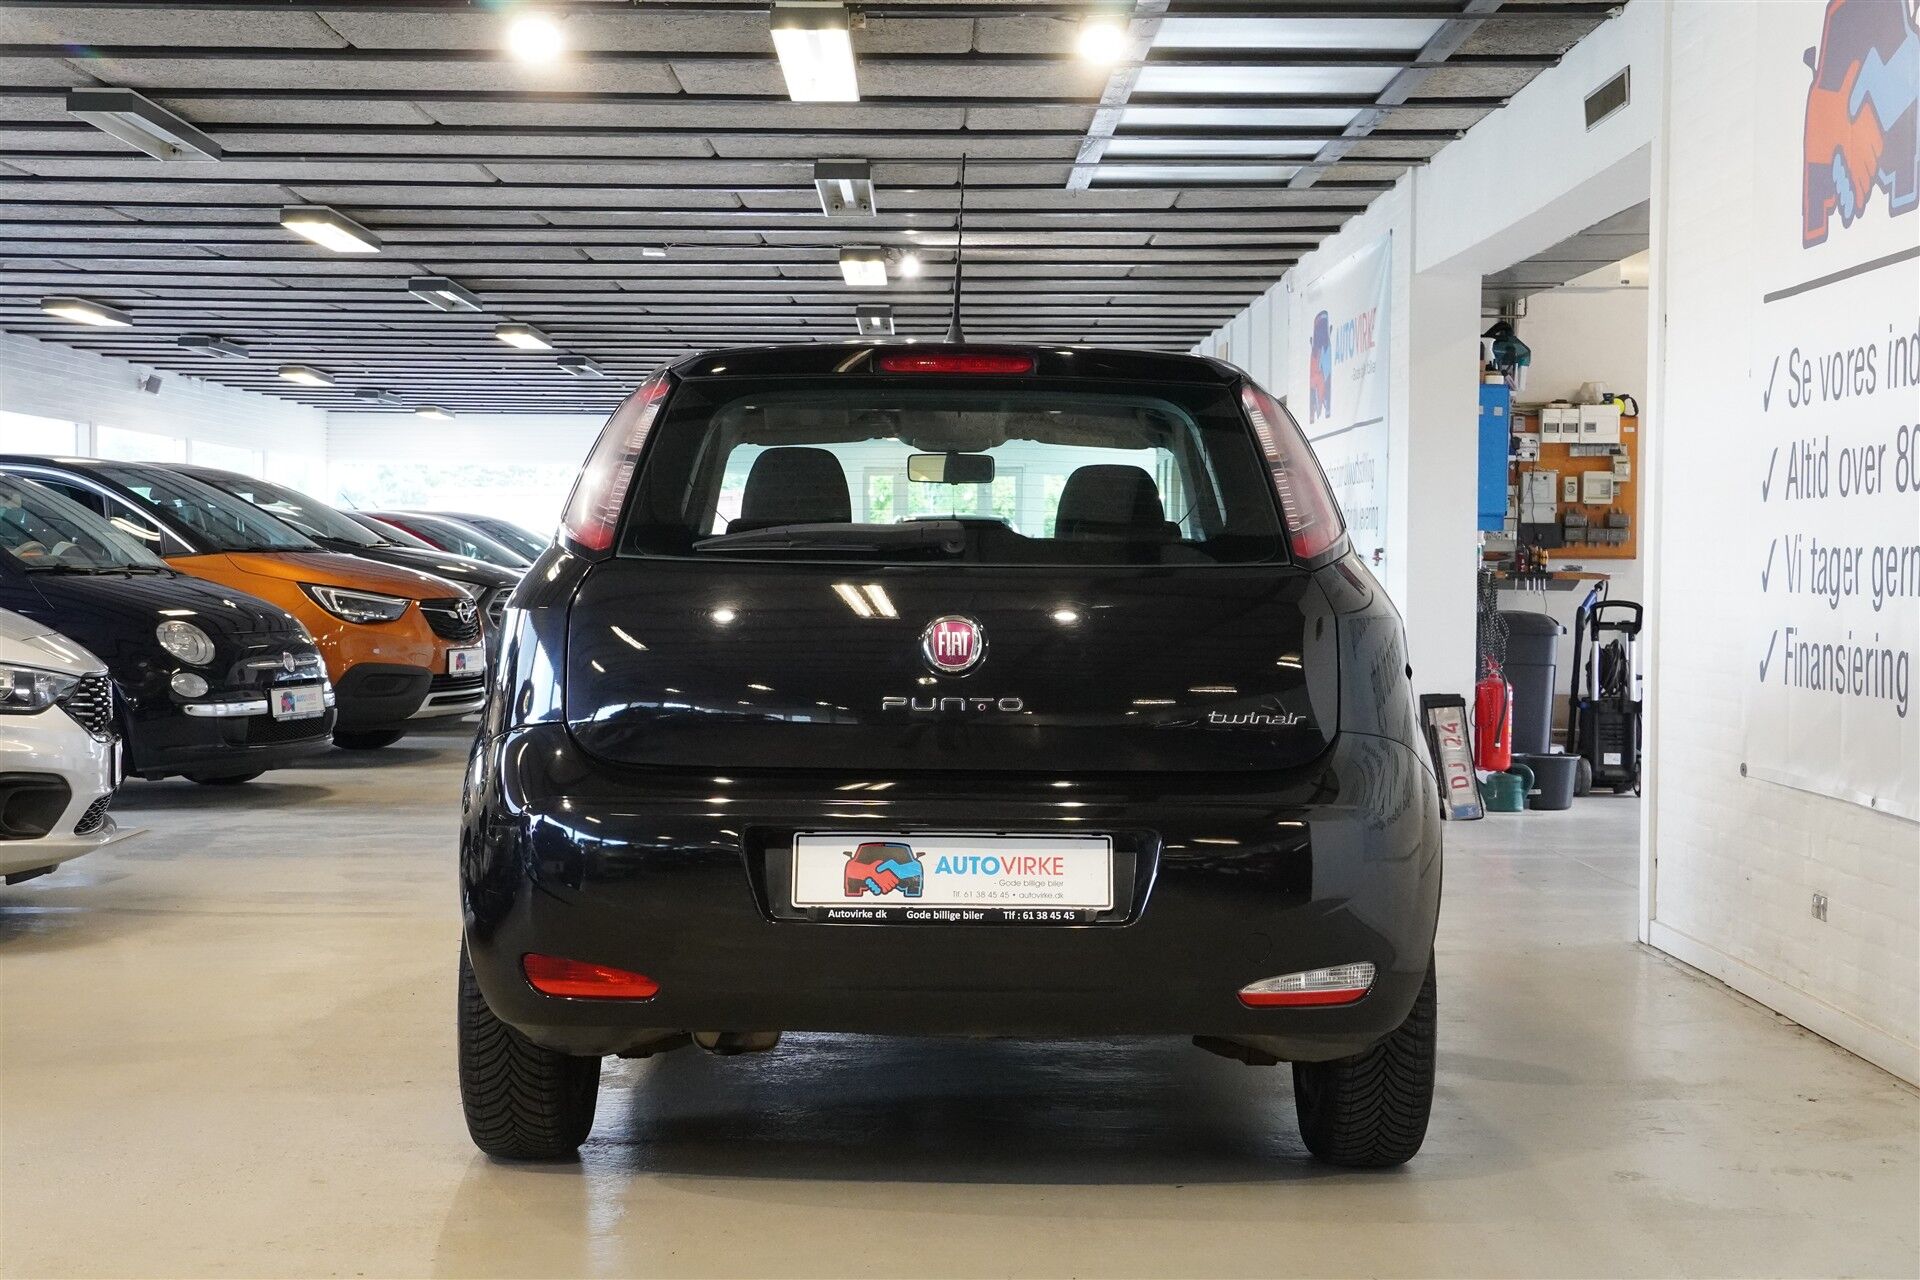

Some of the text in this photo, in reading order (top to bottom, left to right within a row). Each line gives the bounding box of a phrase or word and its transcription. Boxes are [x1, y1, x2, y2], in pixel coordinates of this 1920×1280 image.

[1788, 316, 1920, 409] Se vores ind
[1785, 434, 1829, 501] Altid
[1838, 443, 1887, 498] over
[1785, 533, 1920, 613] Vi tager gern
[937, 630, 971, 658] FIAT
[1784, 626, 1910, 719] Finansiering
[882, 696, 1025, 712] PUNTO
[934, 855, 1064, 876] AUTOVIRKE
[998, 879, 1022, 887] Gode
[1023, 878, 1046, 889] billige
[1047, 879, 1064, 887] biler
[1018, 891, 1064, 899] autovirke.dk
[828, 909, 873, 919] Autovirke
[875, 909, 888, 919] dk
[906, 910, 931, 919] Gode
[933, 910, 961, 922] billige
[962, 911, 984, 920] biler
[1022, 911, 1034, 920] 61
[1036, 911, 1048, 920] 38
[1049, 911, 1062, 920] 45
[1063, 911, 1075, 920] 45
